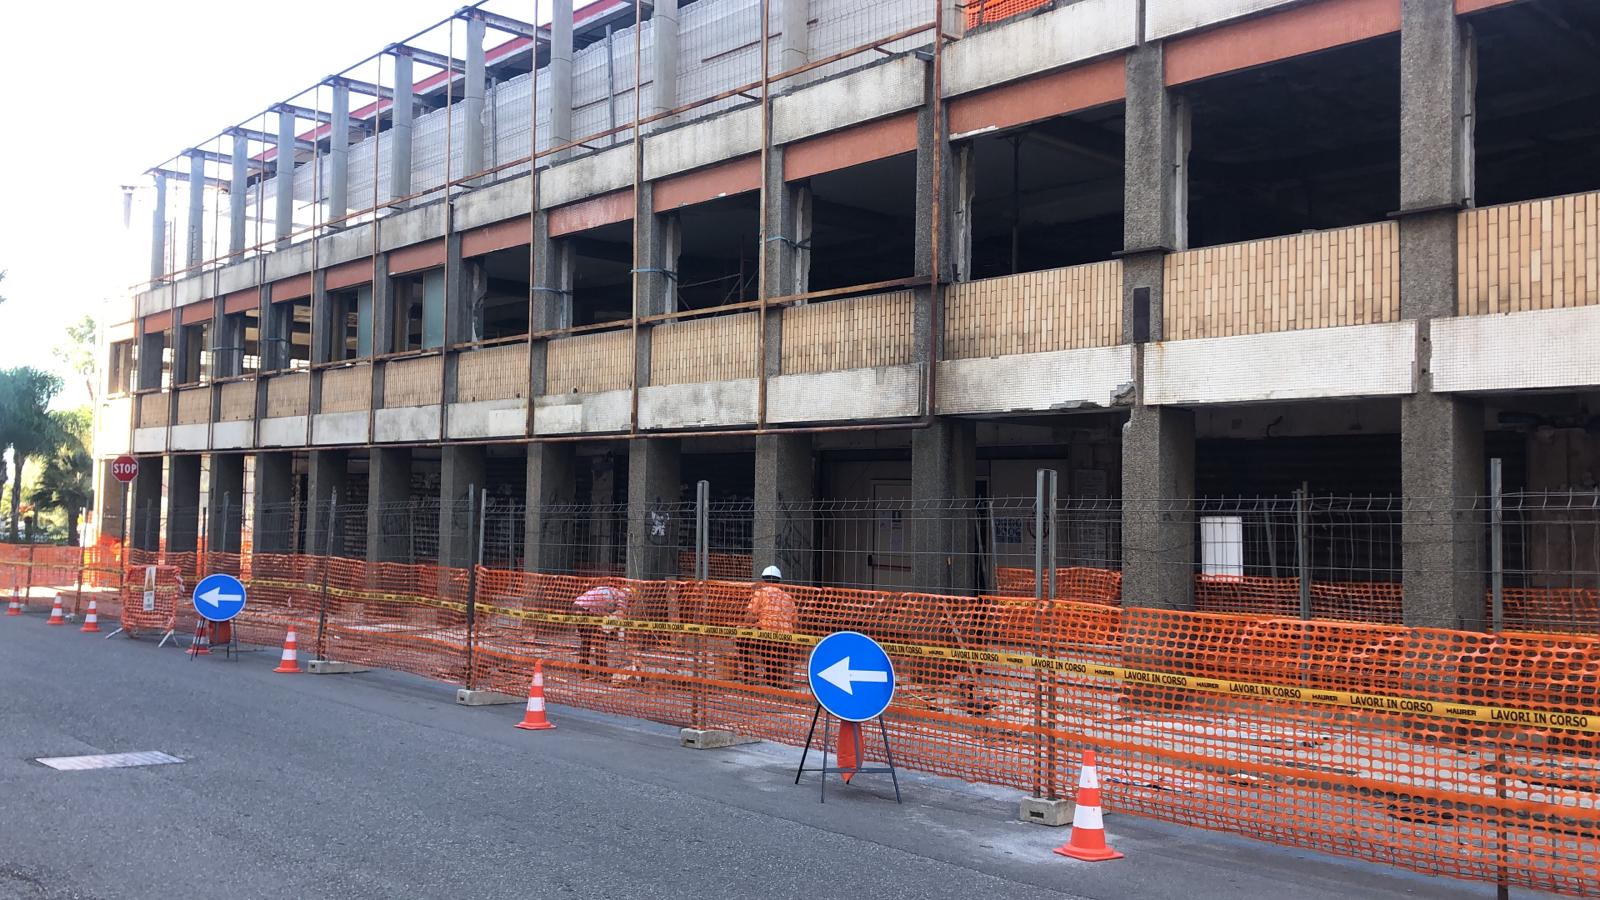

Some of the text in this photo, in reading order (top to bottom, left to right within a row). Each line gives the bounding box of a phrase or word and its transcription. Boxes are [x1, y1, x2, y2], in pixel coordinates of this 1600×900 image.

[113, 463, 137, 474] STOP
[882, 644, 923, 654] AVORI IN CORSO
[951, 650, 999, 662] LAVORI IN CORSO
[1031, 659, 1087, 673] LAVORI IN CORSO
[1124, 670, 1187, 686] LAVORI IN CORSO
[1229, 683, 1301, 699] LAVORI IN CORSO
[1312, 694, 1338, 702] MAURER
[1350, 695, 1433, 713] LAVORI IN CORSO
[1446, 707, 1477, 717] MAURER
[1491, 709, 1588, 728] LAVORI IN CORSO
